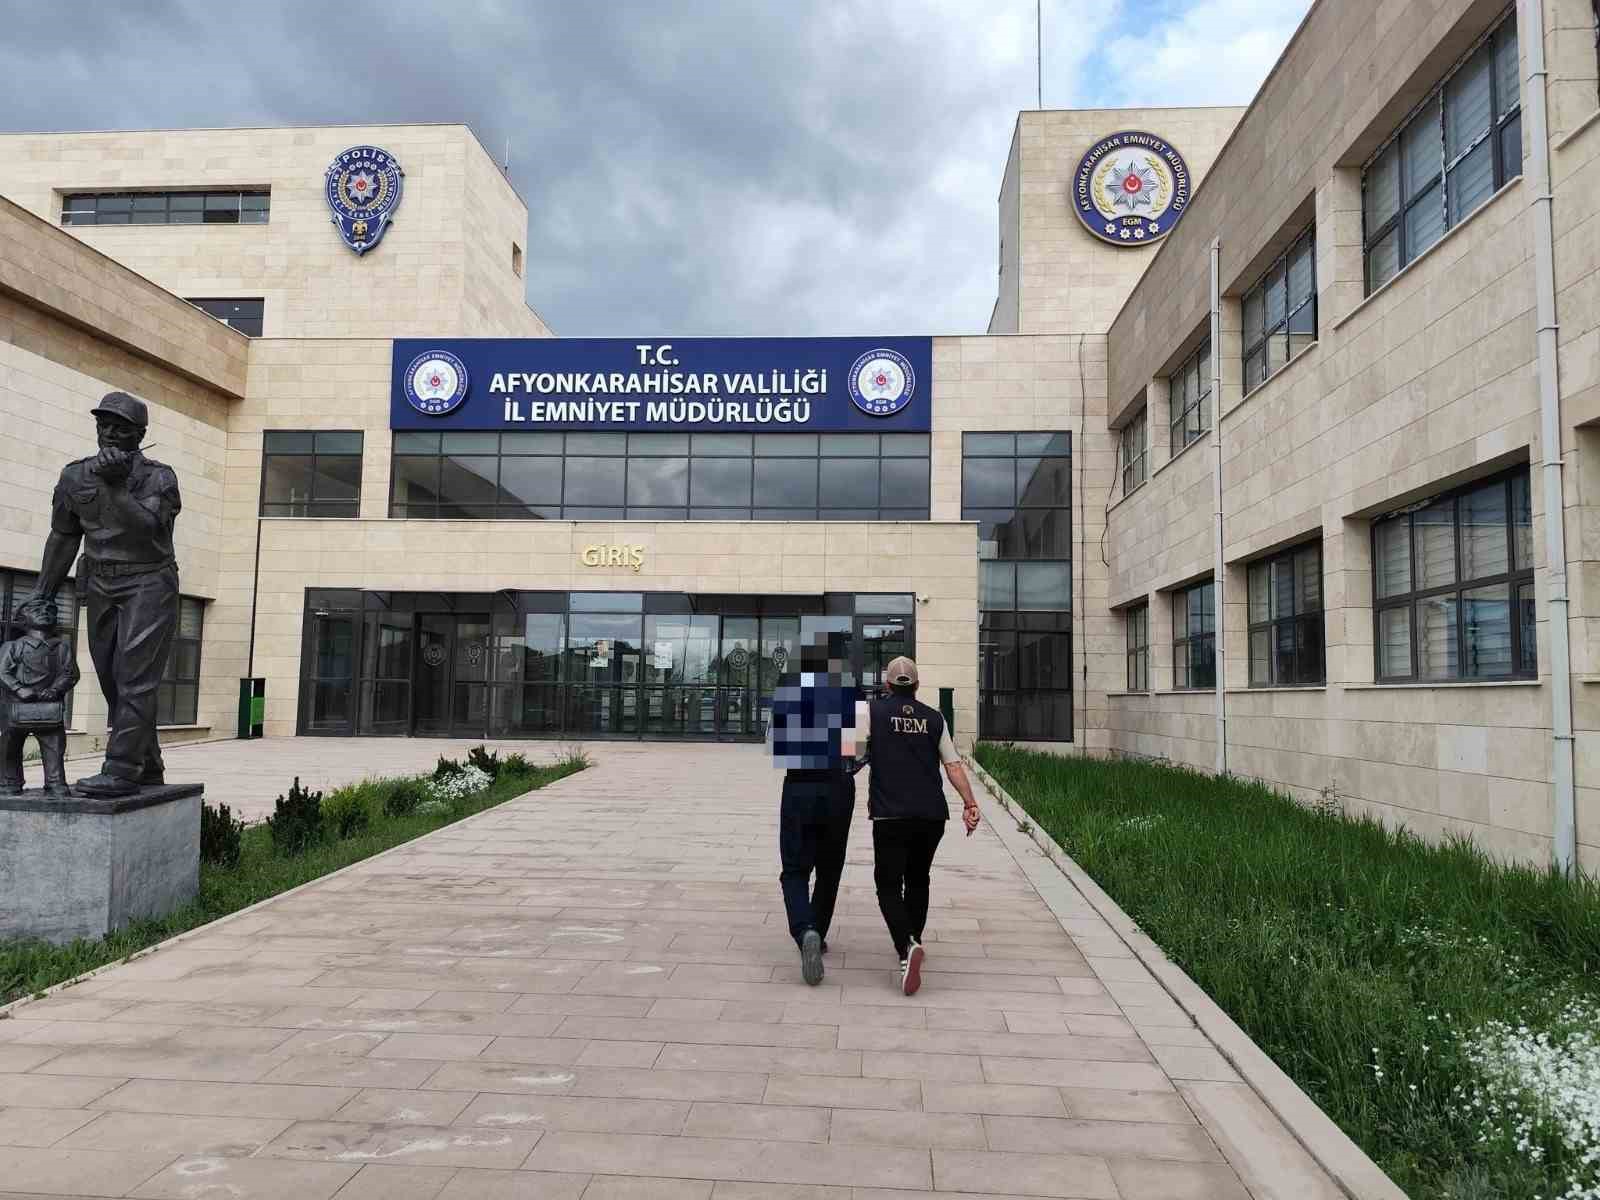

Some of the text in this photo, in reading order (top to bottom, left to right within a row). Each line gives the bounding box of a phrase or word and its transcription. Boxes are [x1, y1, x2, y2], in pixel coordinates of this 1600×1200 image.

[1078, 138, 1120, 211] AFYONKARAHİSAR
[1124, 135, 1166, 151] EMNİYET
[1122, 217, 1142, 226] EGM
[636, 344, 680, 366] T.C.
[489, 368, 718, 393] AFYONKARAHİSAR
[723, 368, 828, 393] VALİLİĞİ
[504, 397, 812, 424] İL EMNİYET MÜDÜRLÜĞÜ
[581, 544, 644, 572] GİRİŞ
[890, 717, 929, 734] TEM
